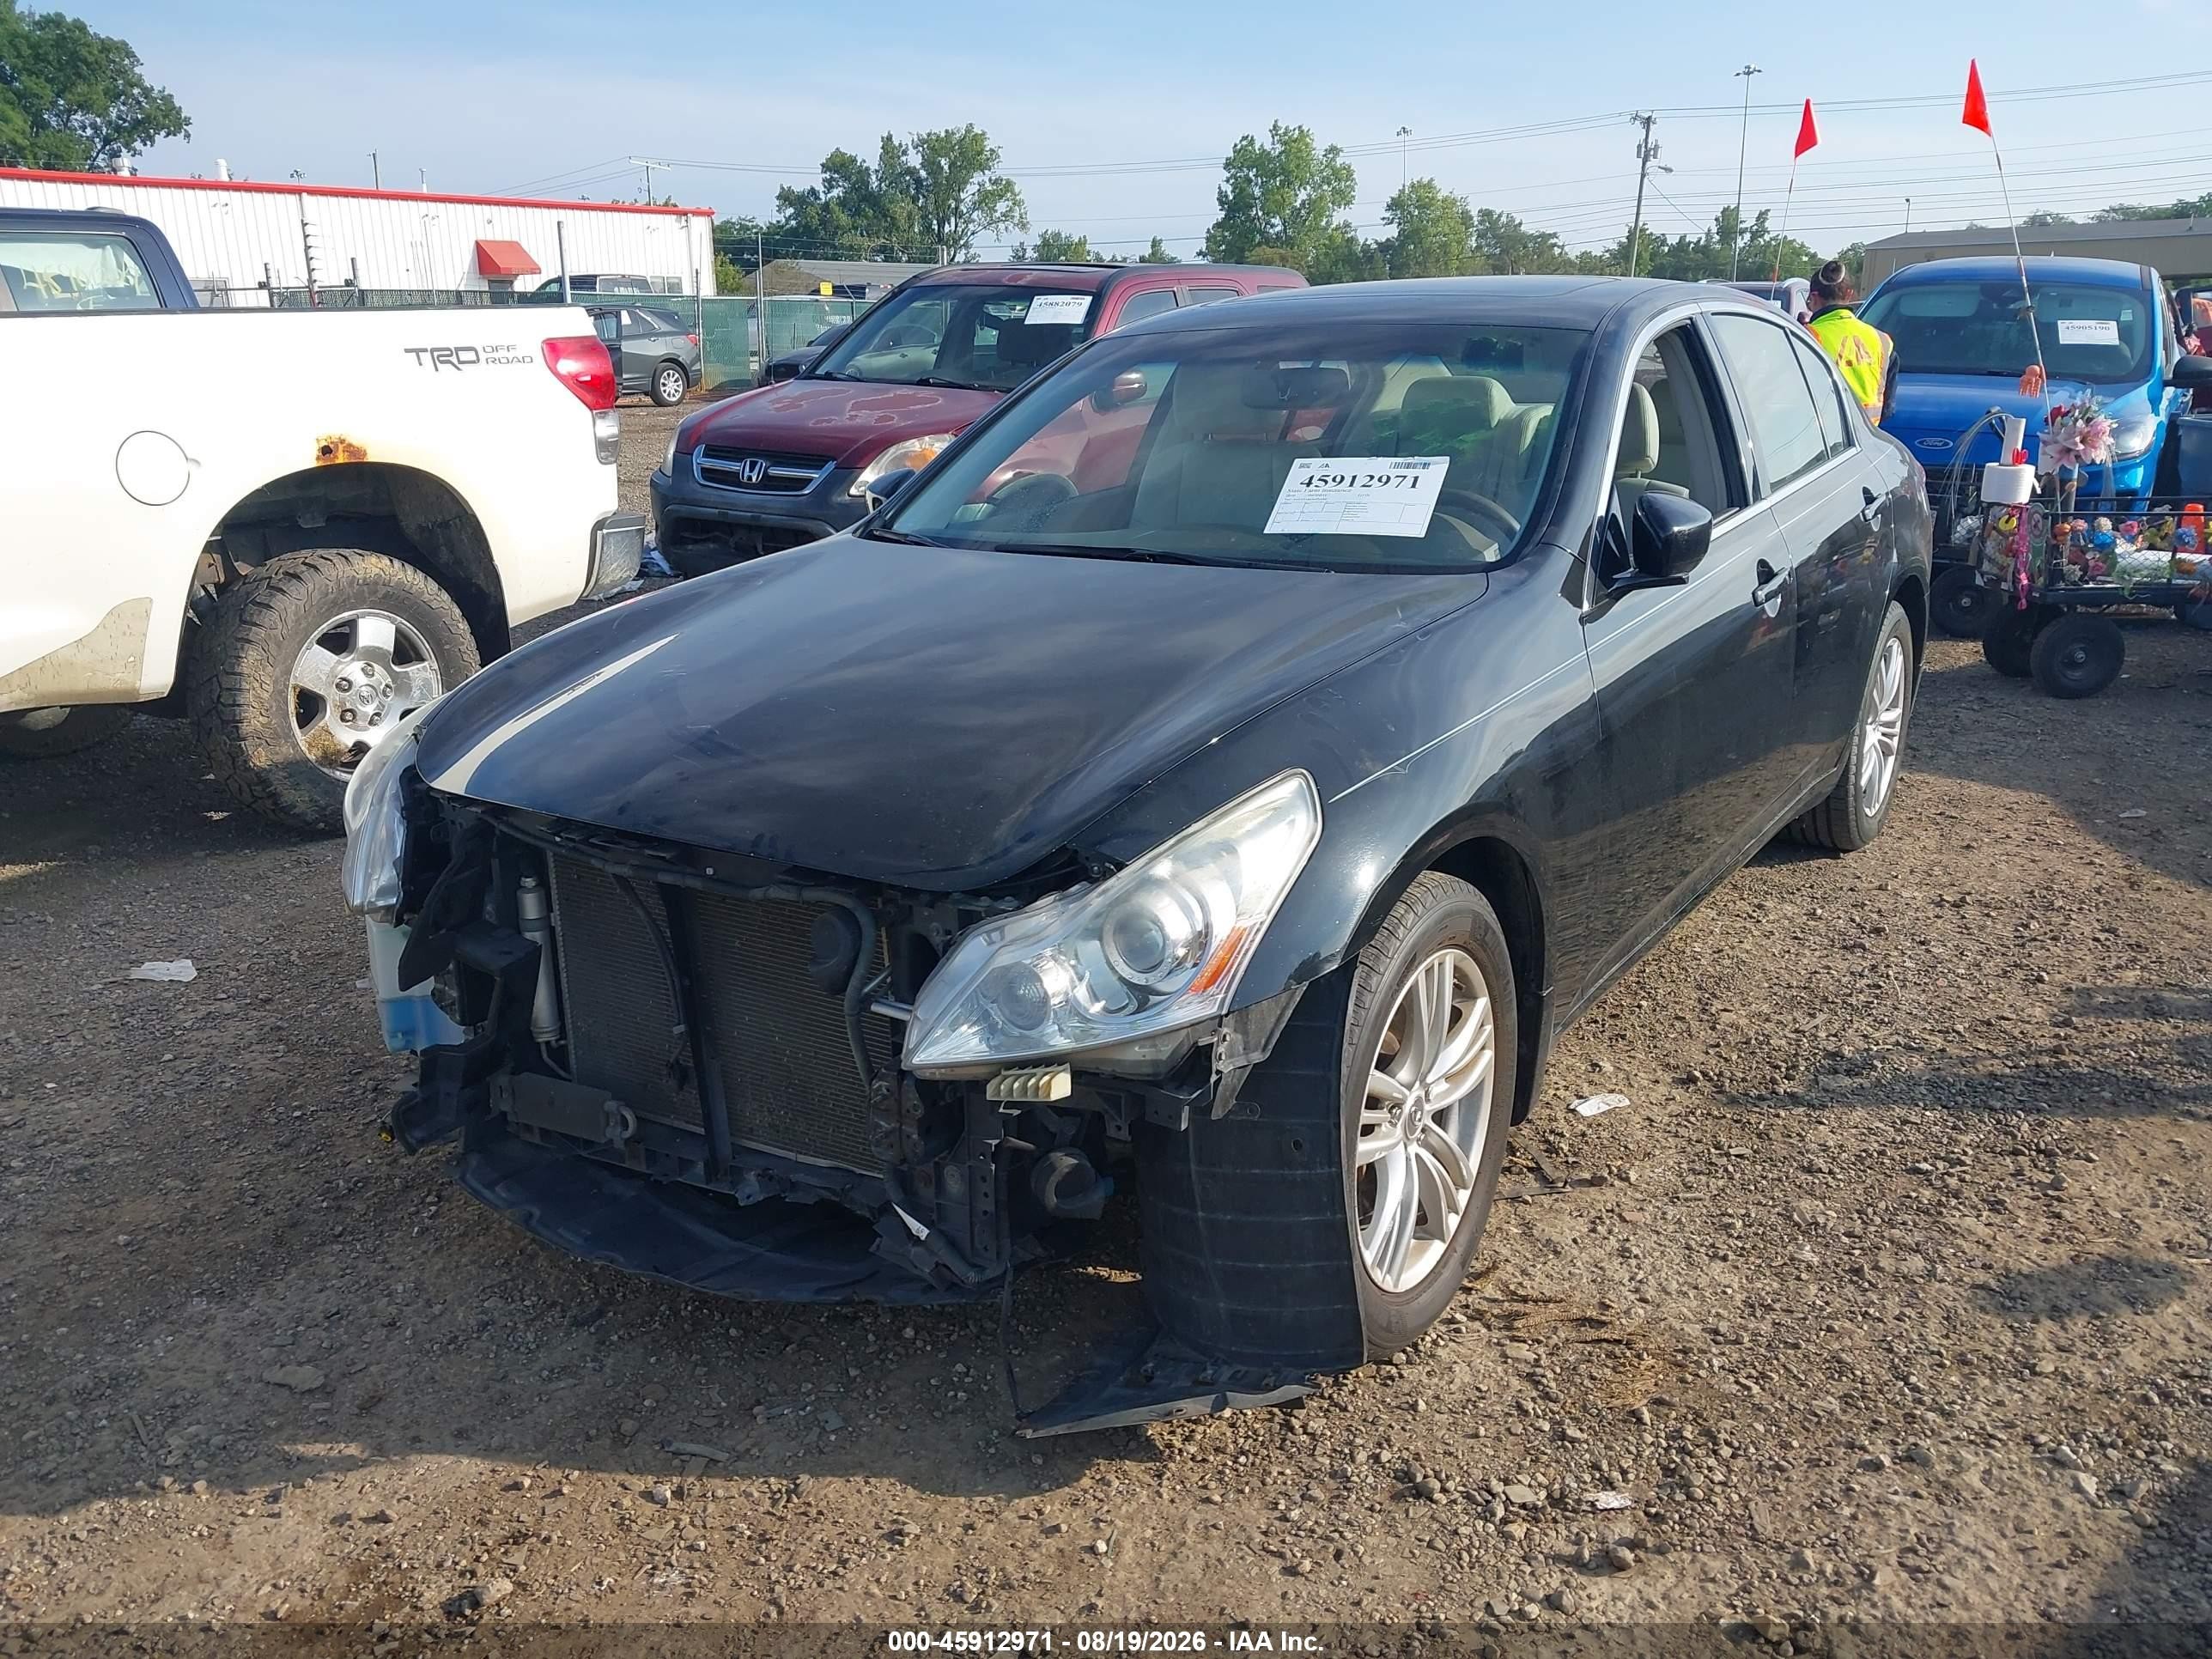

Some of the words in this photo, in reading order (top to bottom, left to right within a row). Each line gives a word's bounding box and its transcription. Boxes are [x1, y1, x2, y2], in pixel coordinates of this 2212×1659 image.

[483, 344, 517, 353] OFF
[404, 346, 480, 372] TRD
[485, 356, 533, 365] ROAD
[1299, 474, 1420, 489] 45912971
